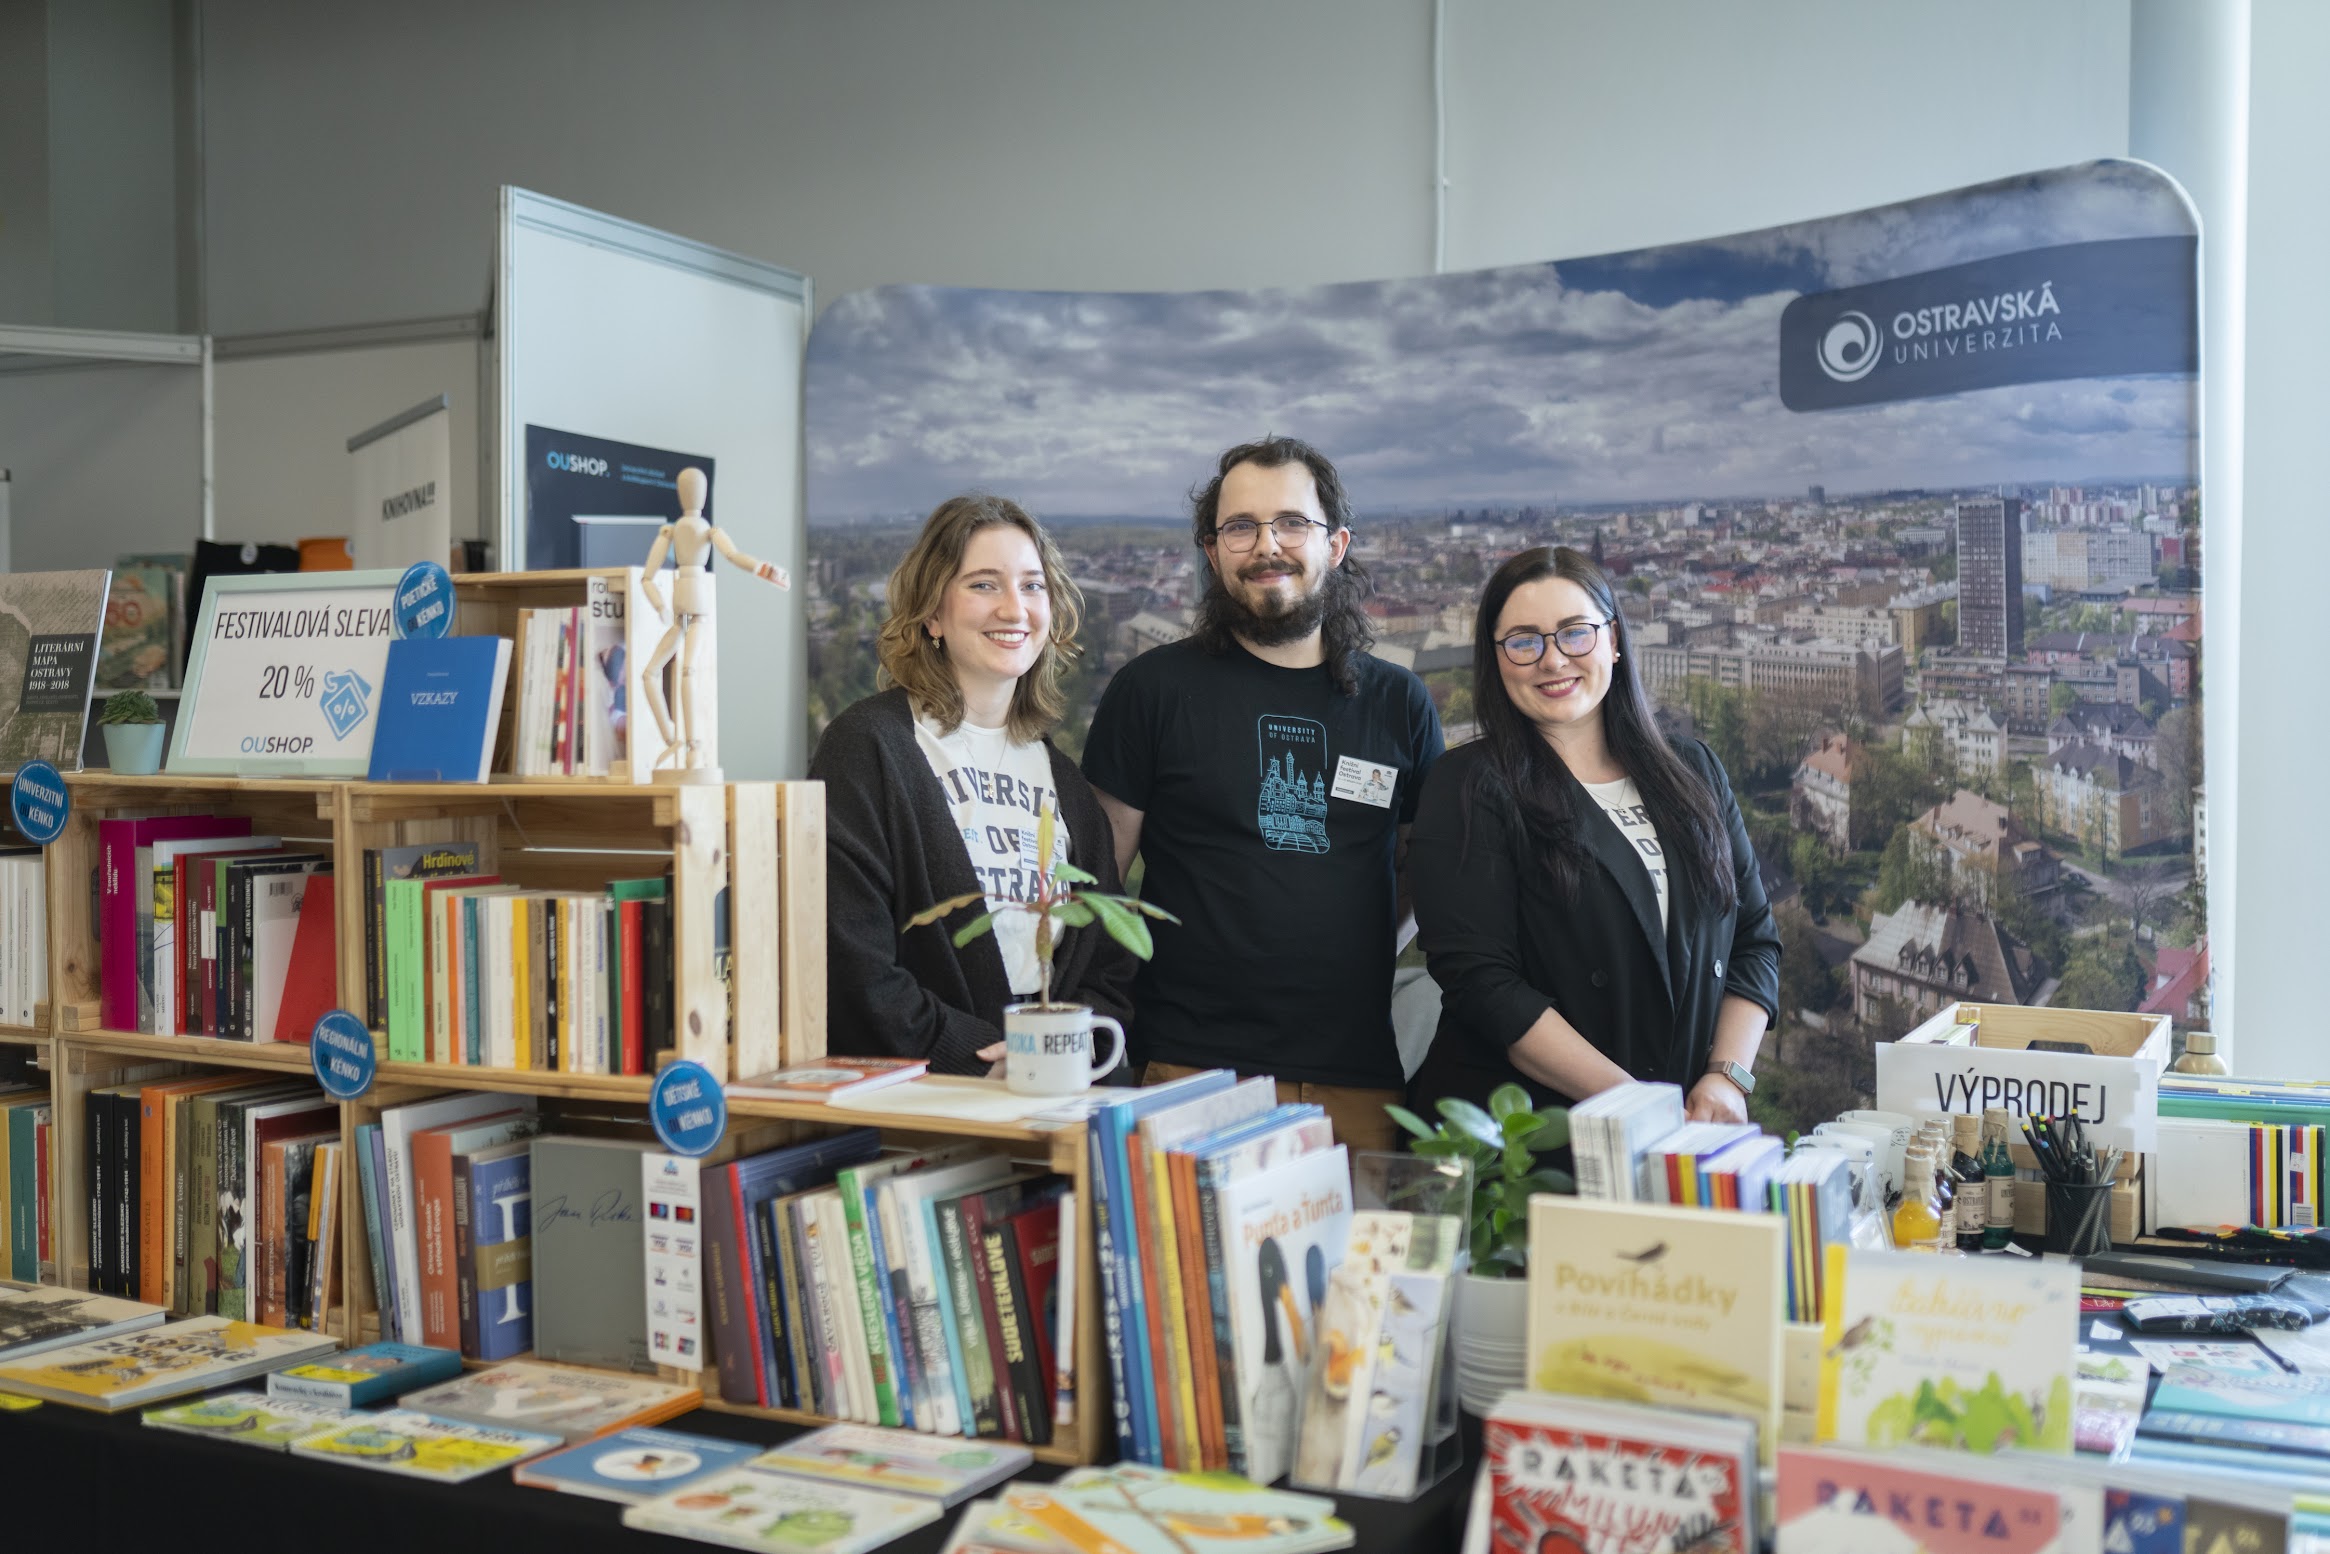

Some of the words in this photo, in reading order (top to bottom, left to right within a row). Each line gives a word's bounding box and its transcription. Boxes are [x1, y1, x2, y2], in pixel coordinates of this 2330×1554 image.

[1893, 280, 2061, 339] OSTRAVSKÁ
[1895, 321, 2063, 364] UNIVERZITA
[215, 605, 332, 639] FESTIVALOVÁ
[334, 608, 391, 637] SLEVA
[33, 656, 58, 666] MAPA
[34, 641, 84, 653] LITERÁRNÍ
[30, 668, 72, 678] OSTRAVY
[259, 666, 289, 699] 20
[294, 665, 315, 698] %
[410, 692, 459, 705] VZKAZY
[1268, 724, 1316, 735] UNIVERSITY
[1281, 734, 1316, 743] OSTRAVA
[18, 777, 64, 809] UNIVERZITNÍ
[422, 851, 475, 870] Hrdinové
[319, 1026, 368, 1059] REGIONÁLNÍ
[1934, 1067, 2107, 1125] VÝPRODEJ
[983, 1233, 1024, 1363] SUDETENLOVE
[1522, 1449, 1696, 1500] RAKETA
[1816, 1479, 2011, 1539] RAKETA
